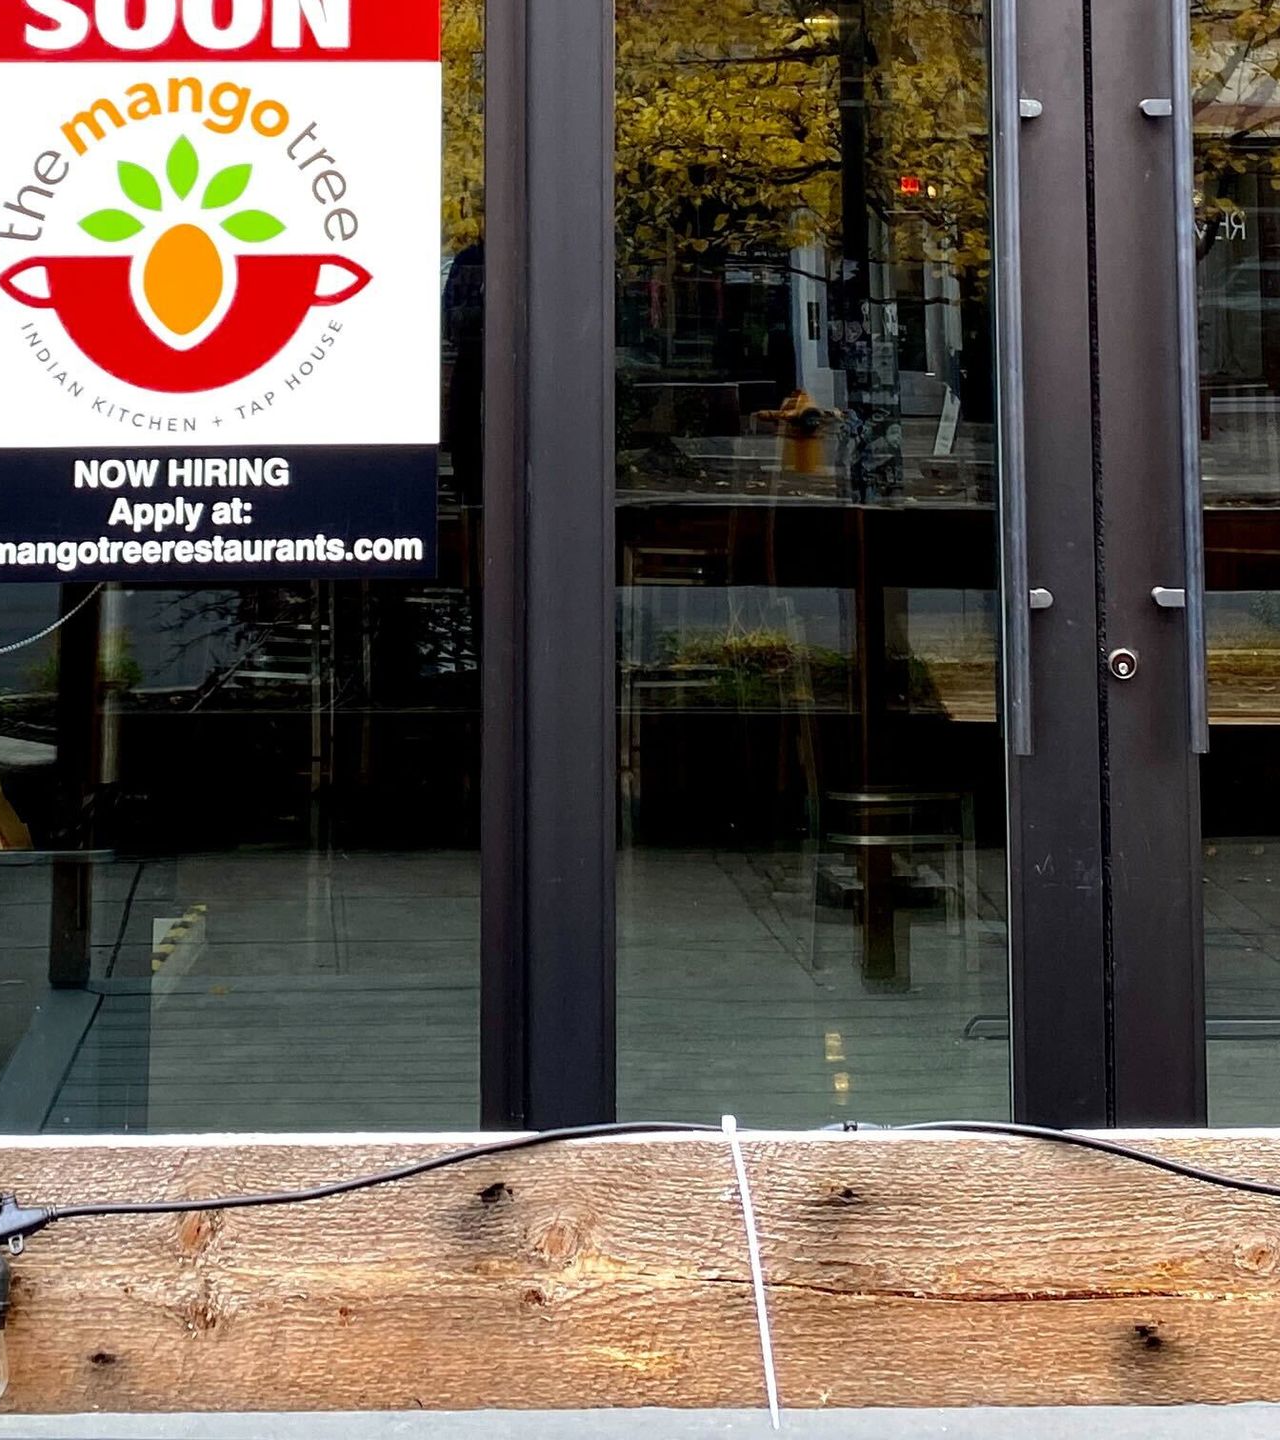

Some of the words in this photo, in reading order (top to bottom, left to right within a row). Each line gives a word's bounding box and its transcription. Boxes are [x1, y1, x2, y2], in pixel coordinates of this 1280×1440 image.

[59, 76, 289, 157] mango
[286, 122, 359, 241] tree
[21, 323, 84, 397] INDIAN
[91, 396, 197, 432] KITCHEN
[235, 391, 275, 420] TAP
[285, 319, 343, 390] HOUSE
[74, 459, 159, 488] NOW
[168, 458, 290, 487] HIRING
[108, 497, 203, 532] Apply
[211, 498, 253, 525] at:
